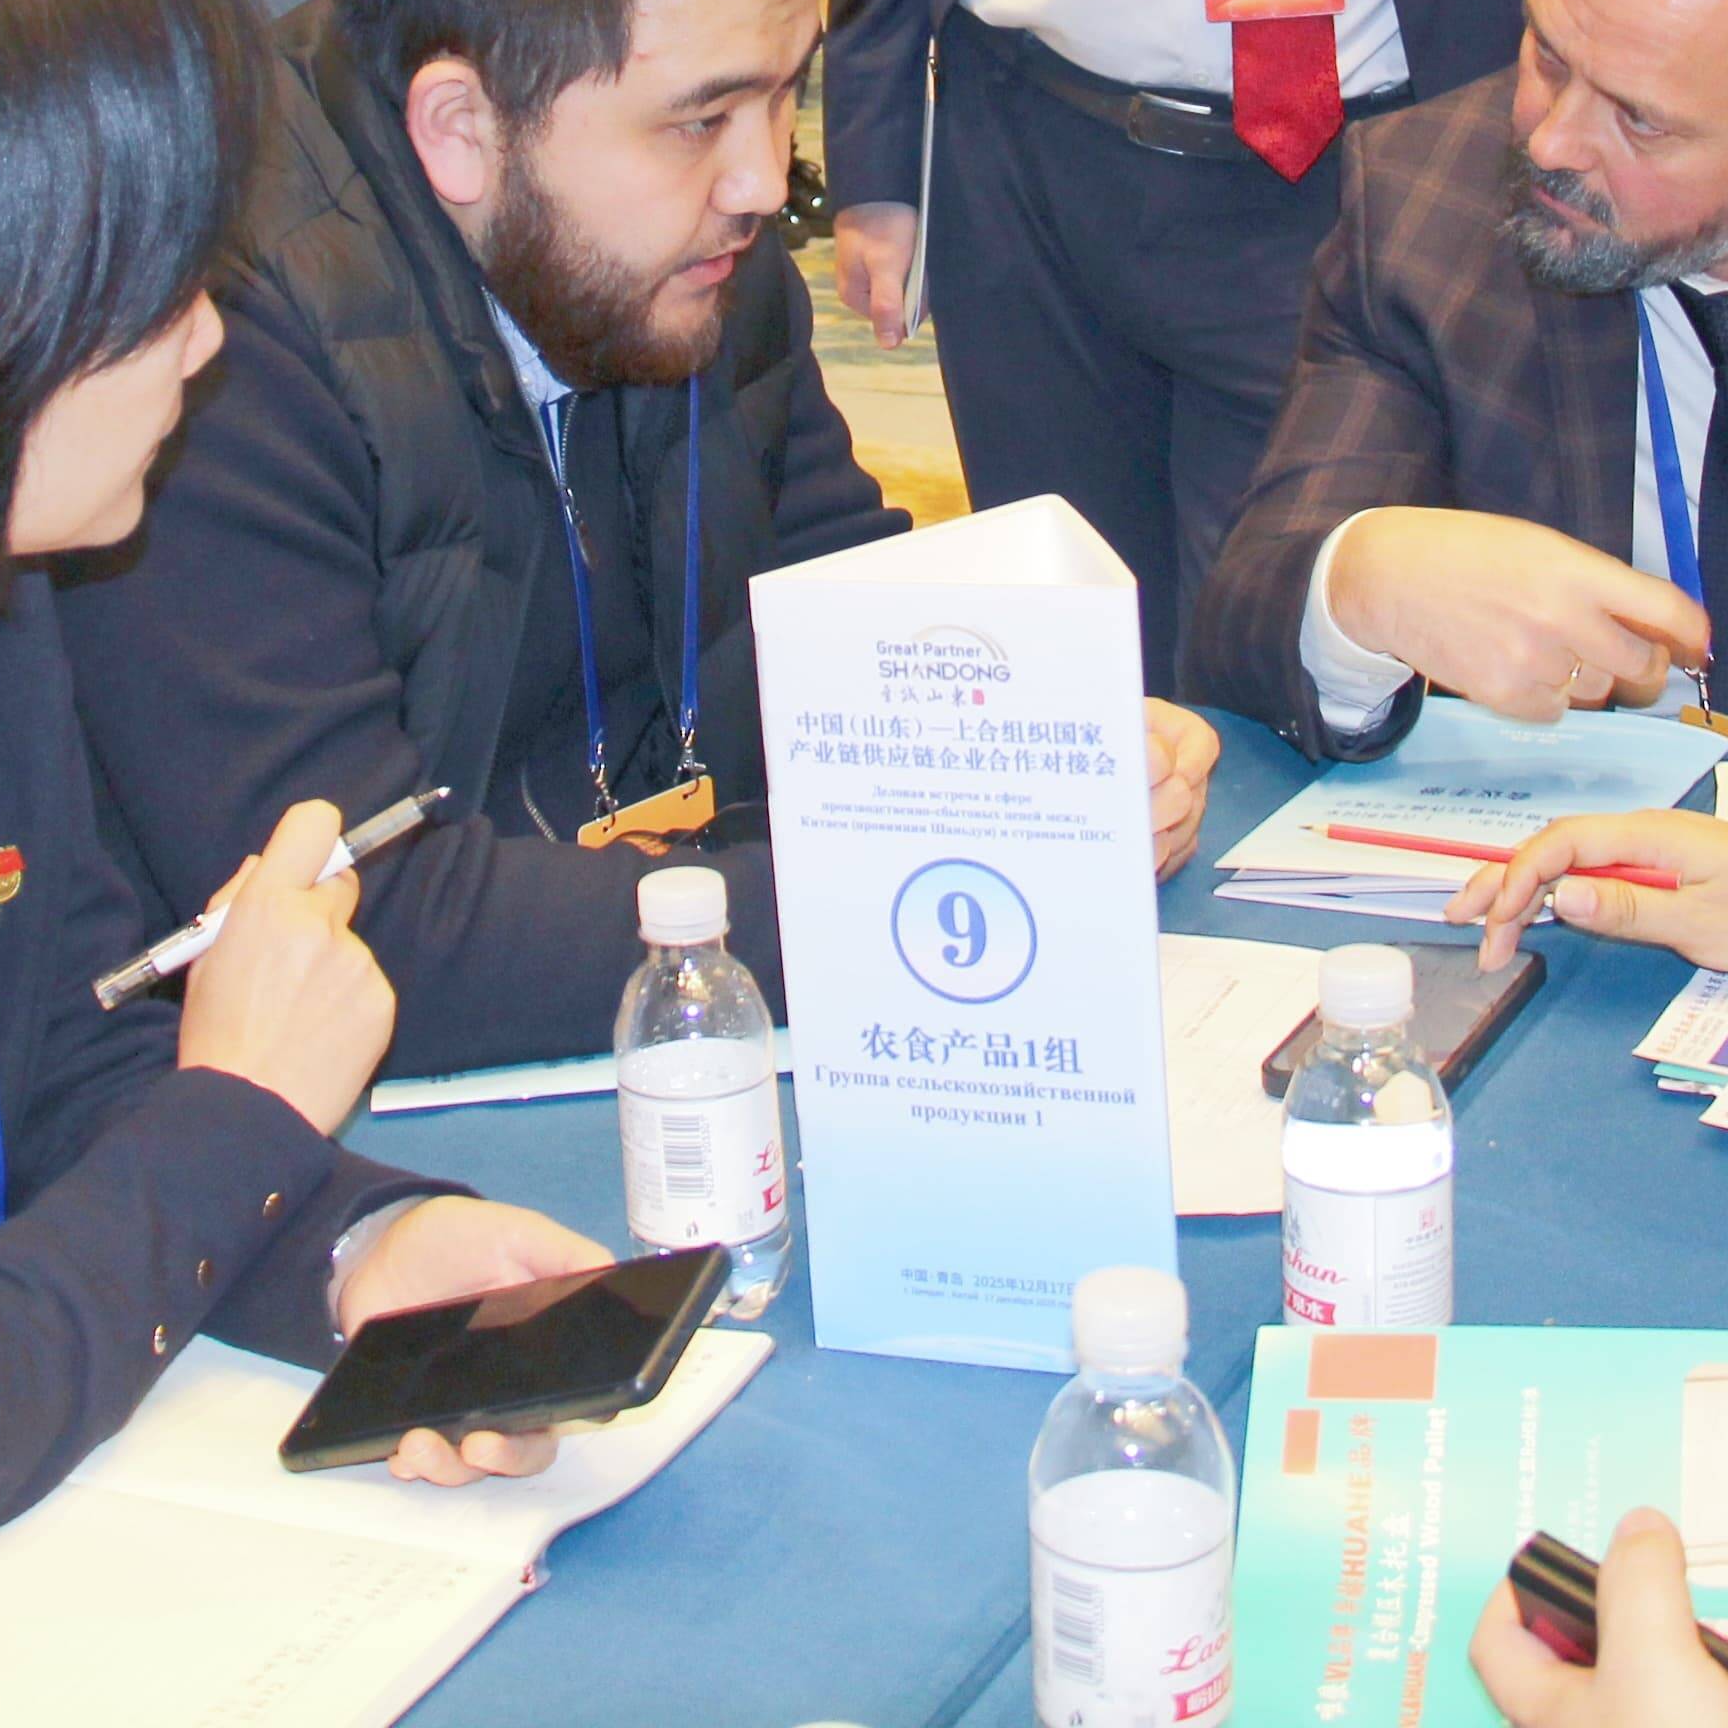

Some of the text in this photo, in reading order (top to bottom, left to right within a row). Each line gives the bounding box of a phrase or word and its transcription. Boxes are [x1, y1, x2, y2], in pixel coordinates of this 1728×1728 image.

[876, 640, 983, 658] Great Partner
[878, 660, 1011, 683] SHANDONG
[788, 738, 1117, 776] 产业链供应链企业合作对接会
[1078, 829, 1118, 843] ШОС
[935, 890, 988, 969] 9
[859, 1022, 1084, 1074] 农食产品1组
[814, 1063, 1137, 1106] Группа сельскохозяйственной
[910, 1102, 1044, 1127] продукции 1
[1424, 1407, 1449, 1474] Pallet
